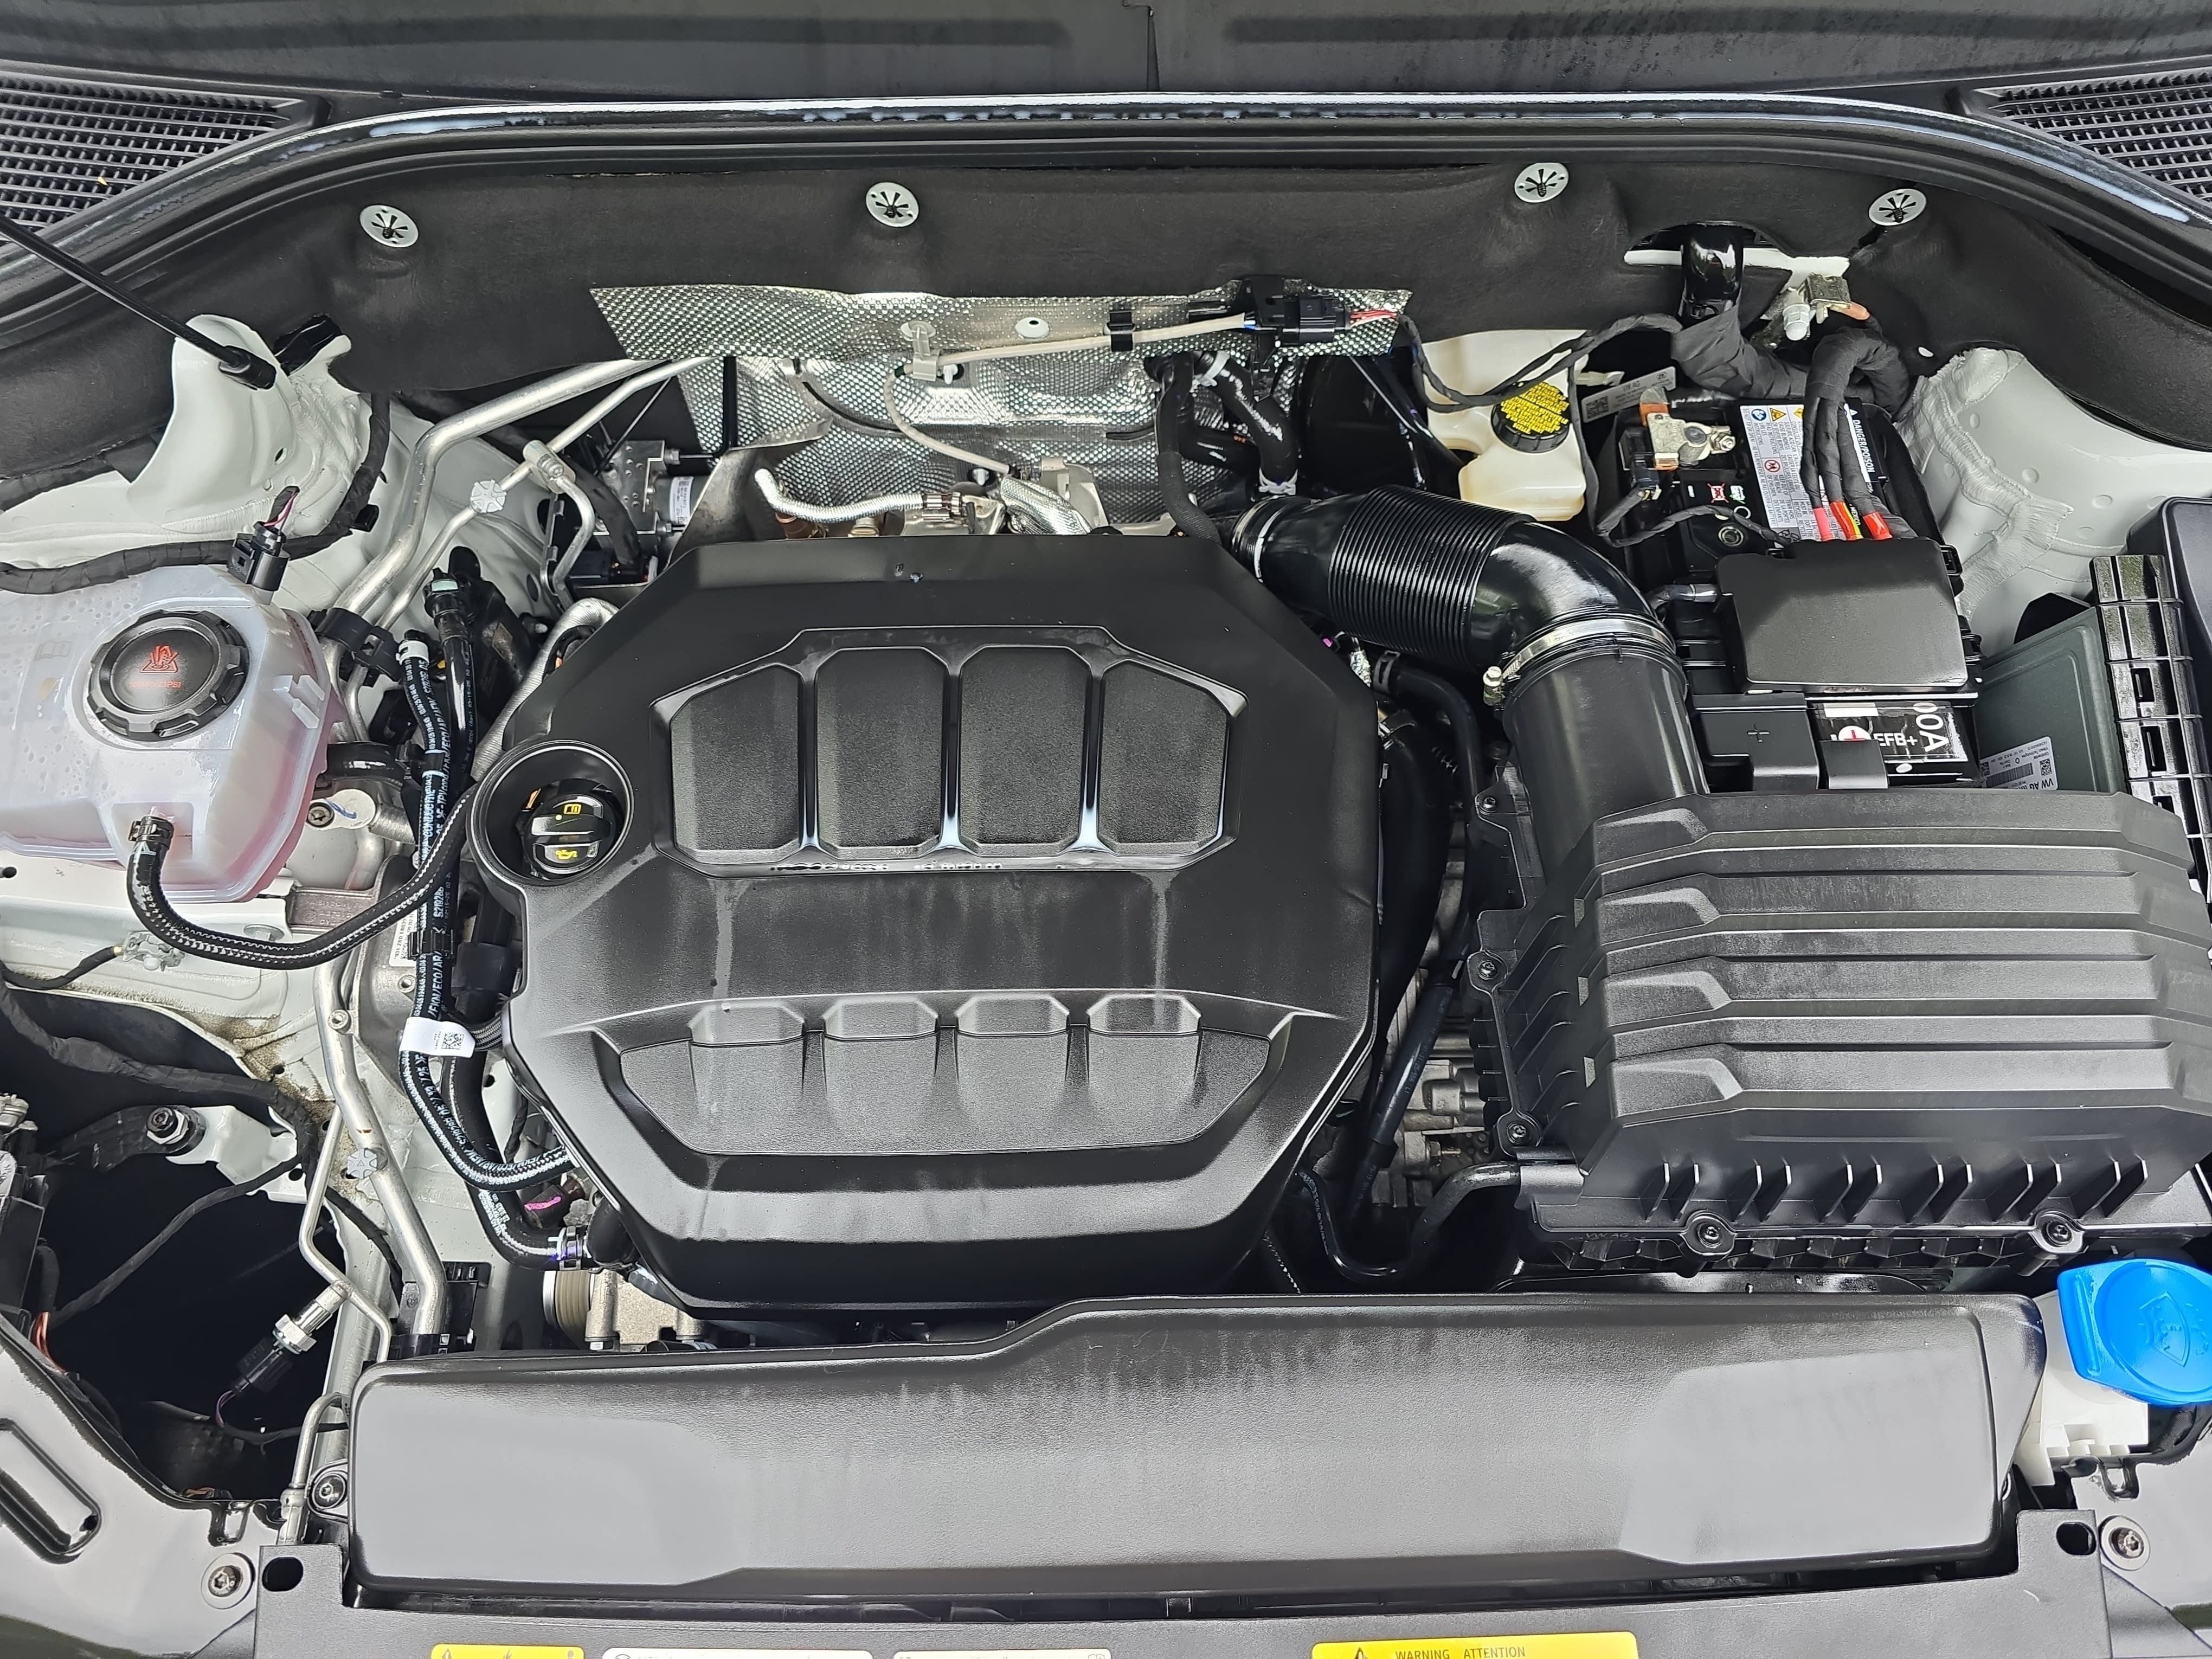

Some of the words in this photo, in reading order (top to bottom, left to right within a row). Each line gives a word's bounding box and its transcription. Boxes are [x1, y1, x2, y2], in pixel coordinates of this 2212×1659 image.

[1853, 420, 1875, 473] DANGER/POISON
[1850, 507, 1860, 525] MEXICO
[1873, 732, 1918, 747] EFB+
[2029, 781, 2039, 790] AG
[2040, 777, 2054, 787] VW
[1395, 1649, 1450, 1659] WARNING
[1463, 1647, 1526, 1658] ATTENTION
